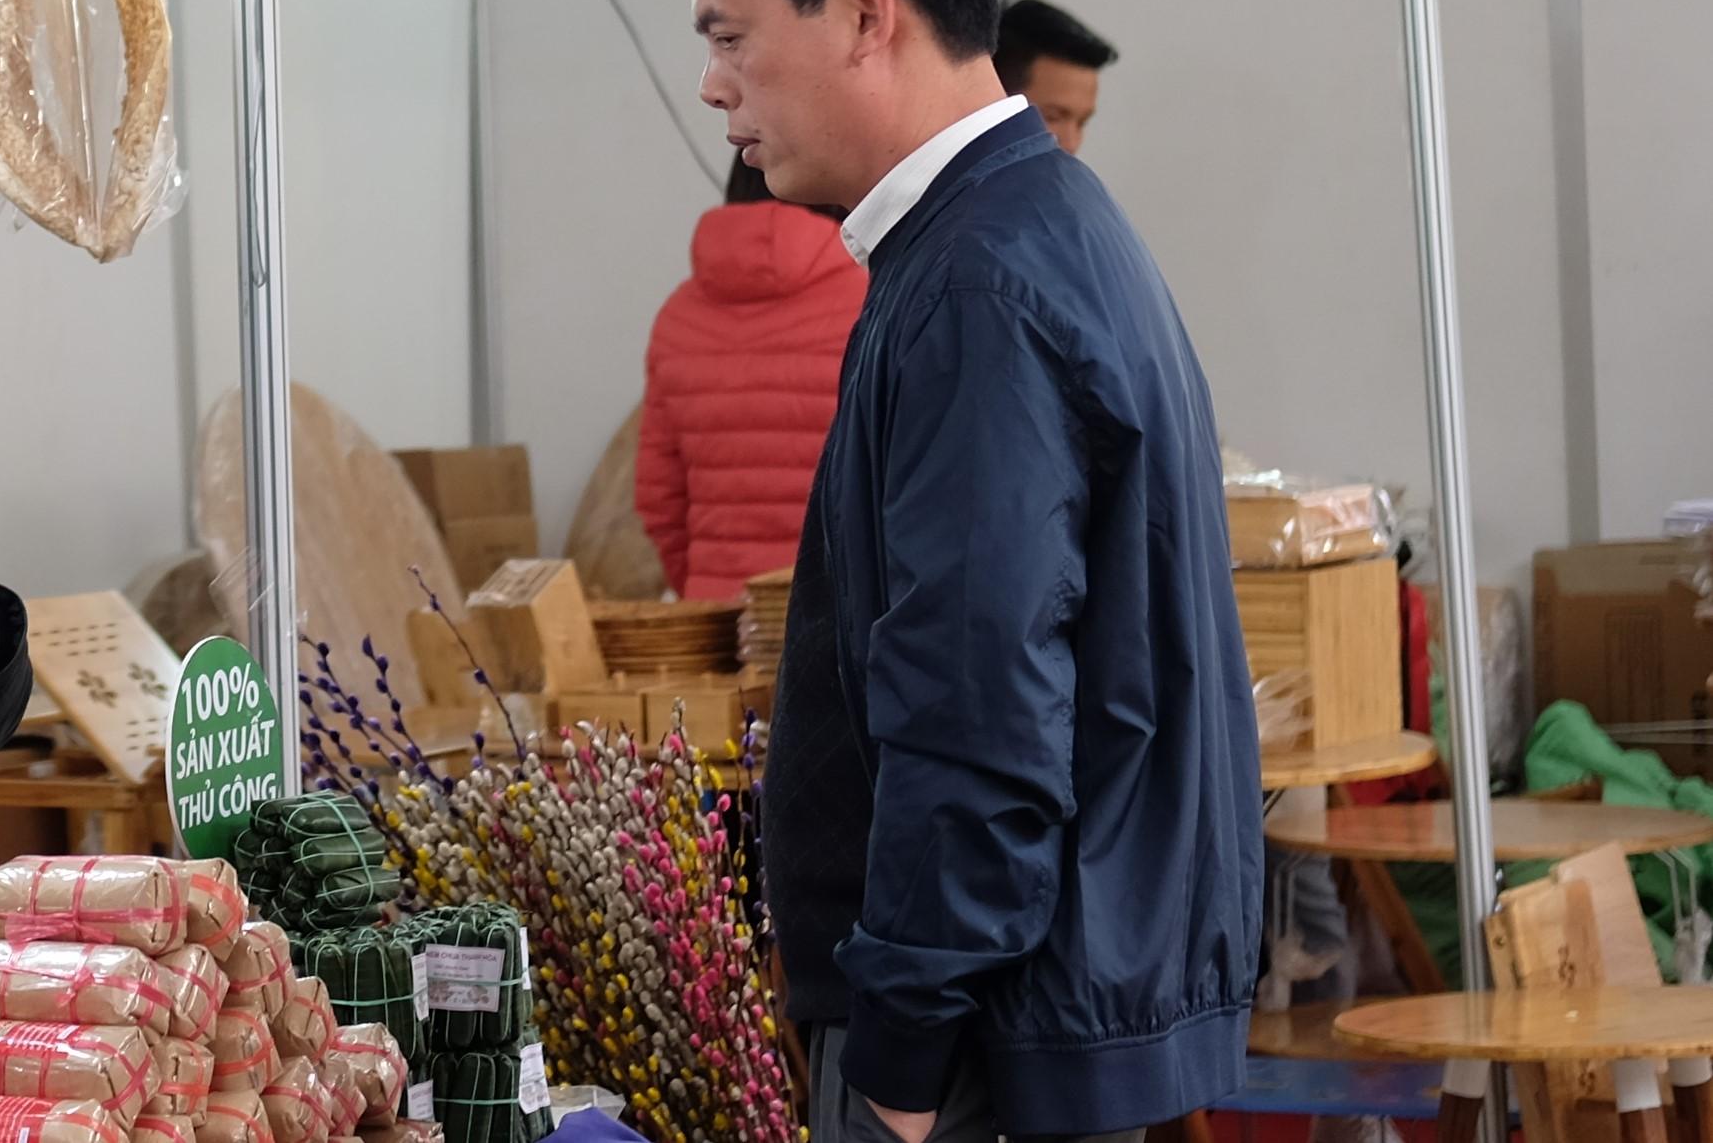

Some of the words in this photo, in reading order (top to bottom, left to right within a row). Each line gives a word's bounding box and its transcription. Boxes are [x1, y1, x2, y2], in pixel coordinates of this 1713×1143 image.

[182, 662, 260, 725] 100%
[176, 727, 214, 780] SẢN
[216, 710, 275, 769] XUẤT
[178, 779, 214, 830] THỦ
